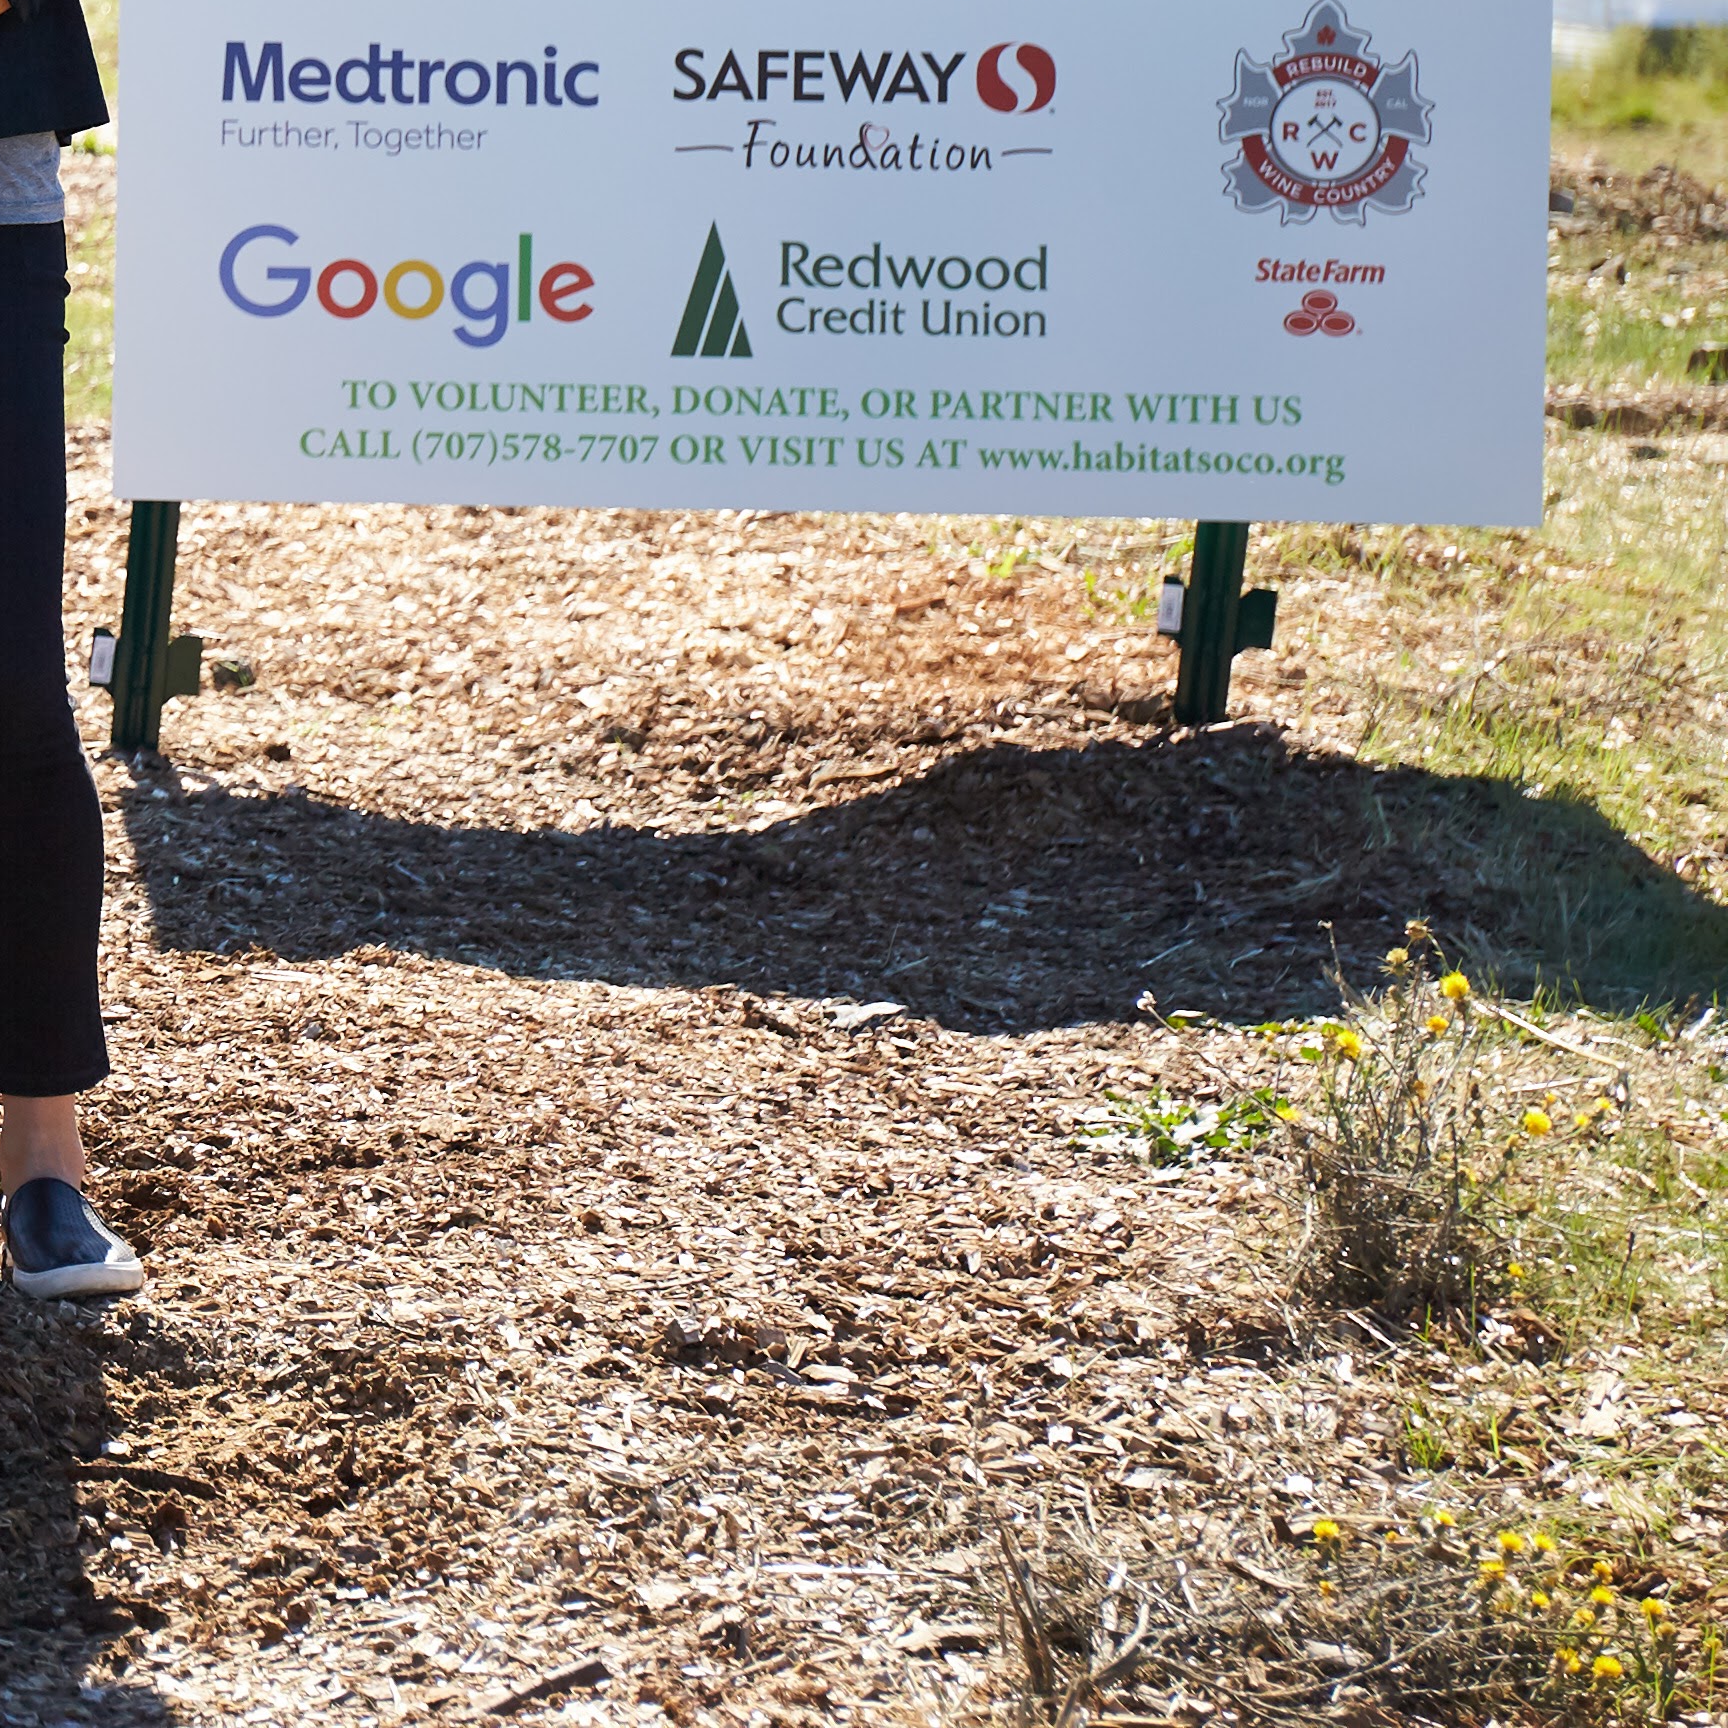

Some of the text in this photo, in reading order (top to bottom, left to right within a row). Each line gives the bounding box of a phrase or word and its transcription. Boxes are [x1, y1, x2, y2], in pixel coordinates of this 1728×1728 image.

[222, 42, 599, 107] Medtronic
[674, 49, 966, 103] SAFEWAY
[1285, 56, 1368, 79] REBUILD
[222, 119, 488, 156] Further, Together
[743, 120, 991, 170] Foundation
[1282, 122, 1367, 143] R C
[1258, 156, 1395, 204] WINE COUNTRY
[1311, 150, 1339, 171] W
[219, 225, 595, 348] Google
[781, 242, 1047, 291] Redwood
[777, 297, 1045, 336] Credit Union
[342, 381, 1301, 425] TO VOLUNTEER, DONATE, OR PARTNER WITH US
[300, 429, 1345, 485] CALL (707)578-7707 OR VISIT US AT www.habitatsoco.org
